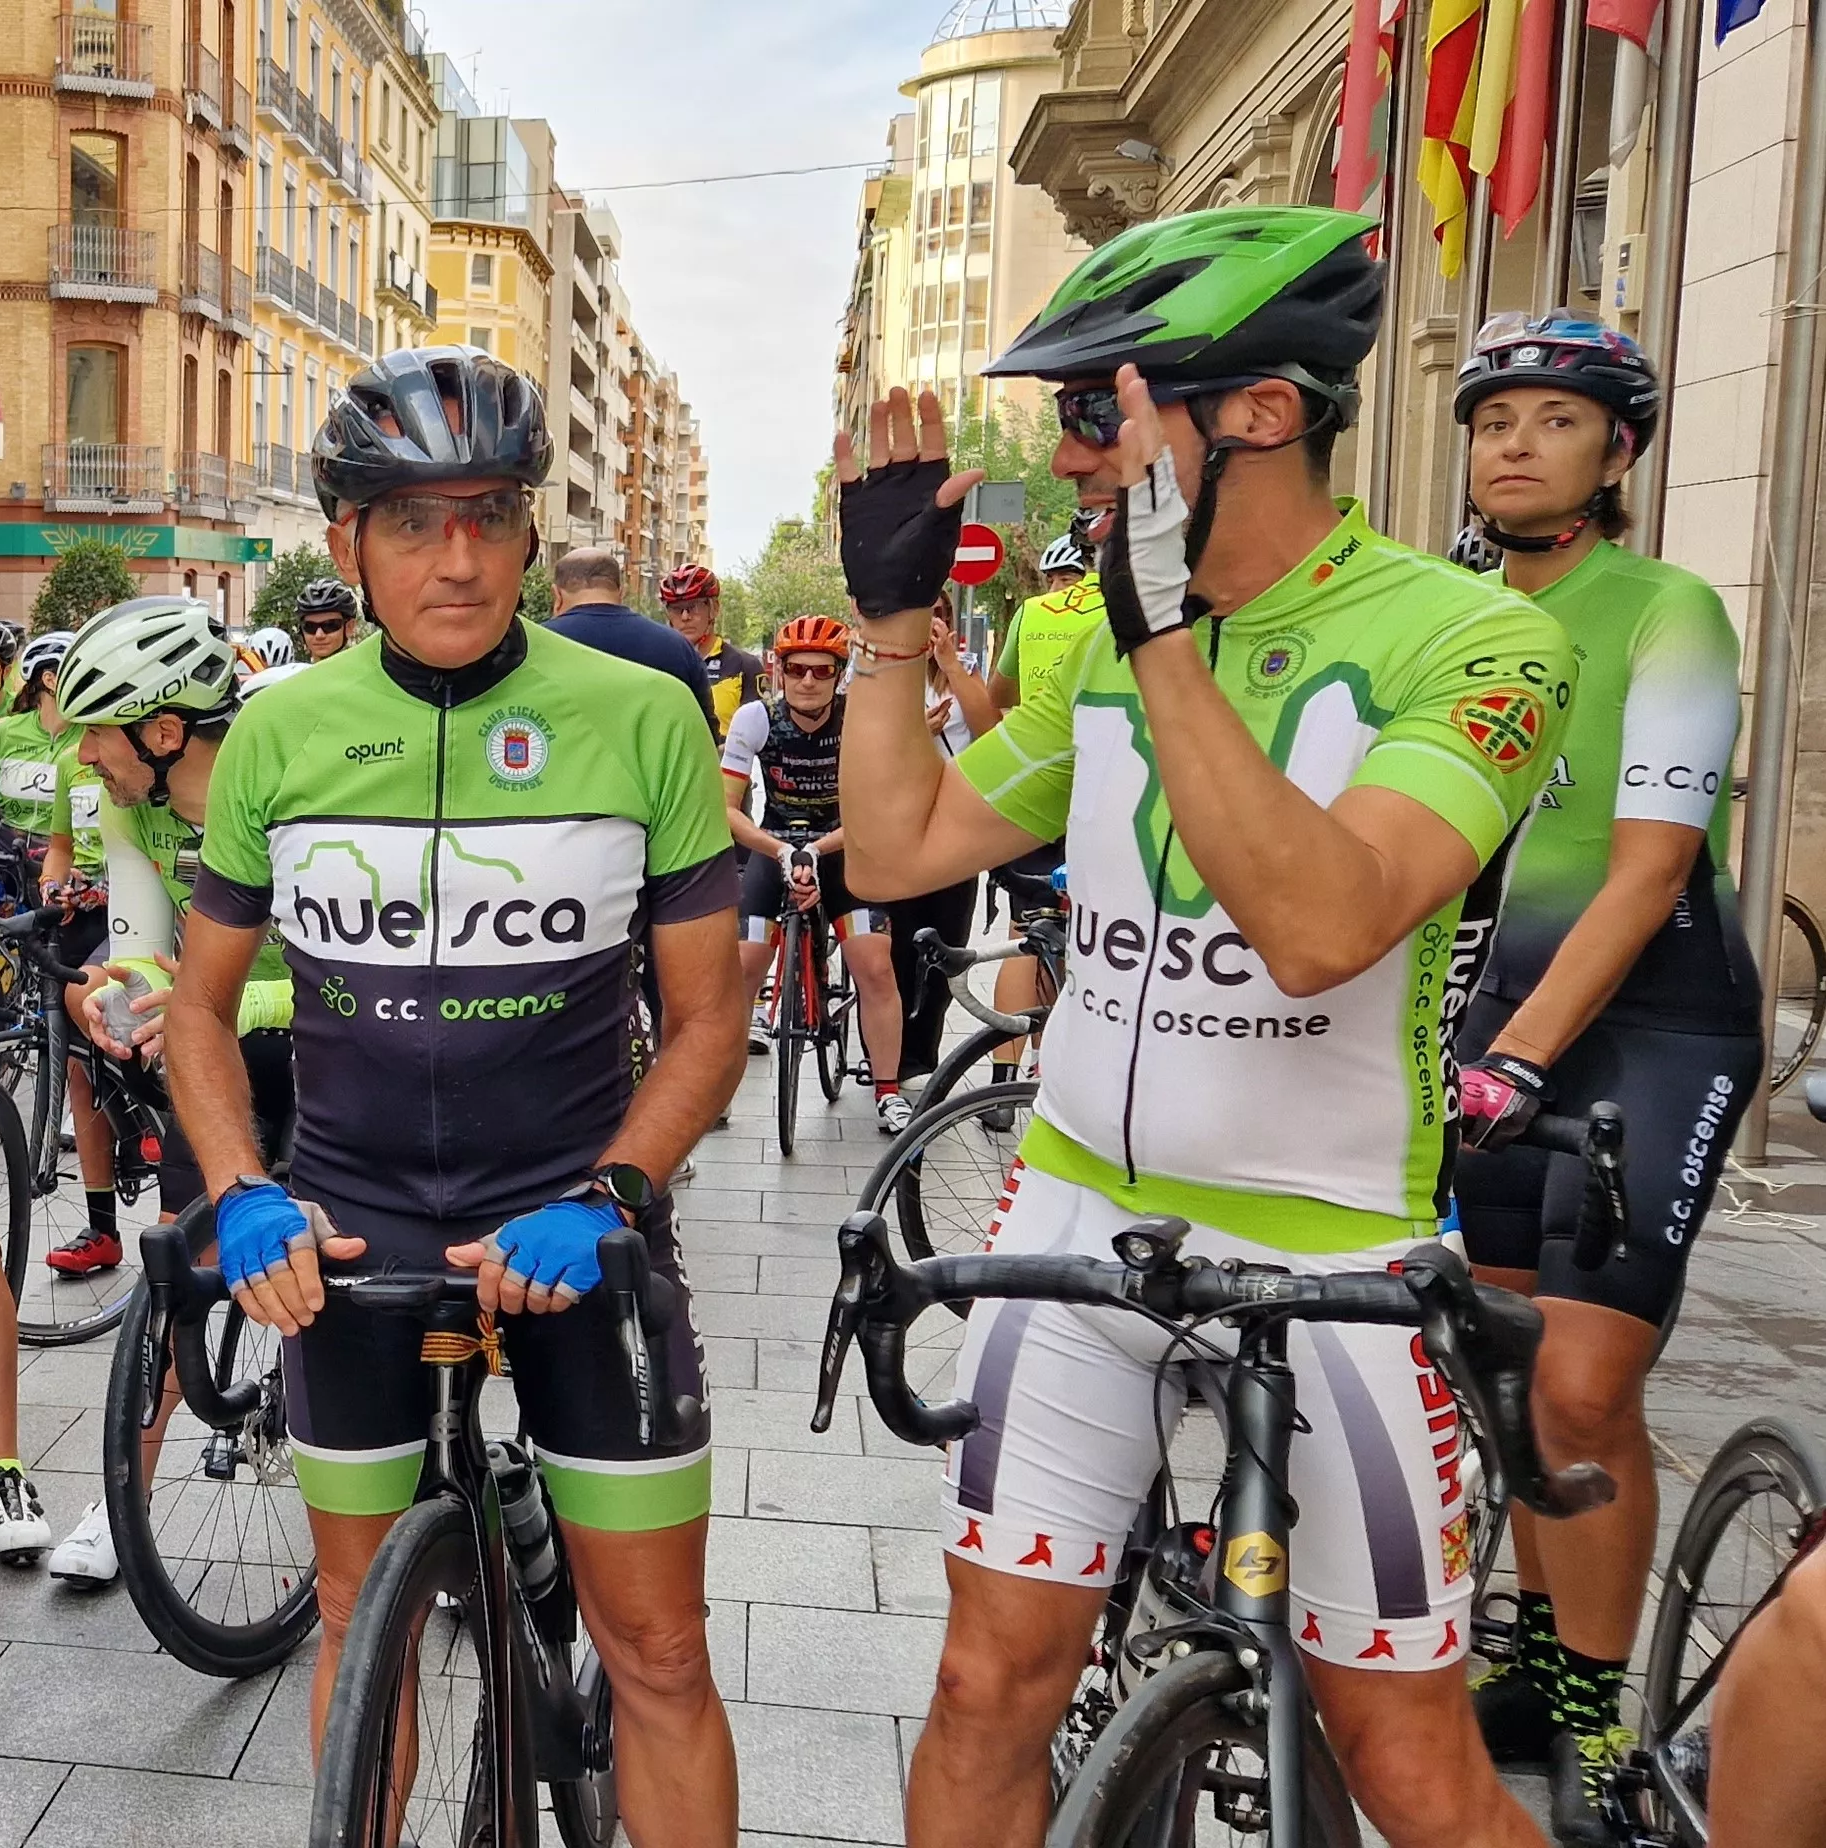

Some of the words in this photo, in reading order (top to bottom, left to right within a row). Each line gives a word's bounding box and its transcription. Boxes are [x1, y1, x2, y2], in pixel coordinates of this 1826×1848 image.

[345, 736, 405, 765] apunt
[478, 708, 506, 738] CLUB
[1624, 764, 1719, 796] C.C.O
[293, 885, 587, 949] huesca
[1070, 903, 1254, 987] uesc
[375, 997, 425, 1021] c.c.
[439, 990, 566, 1021] oscense
[1083, 988, 1128, 1026] c.c.
[1152, 1008, 1331, 1039] oscense
[1436, 917, 1493, 1124] huesca
[1413, 1024, 1436, 1127] oscense
[1665, 1198, 1695, 1245] c.c.
[1680, 1074, 1734, 1187] oscense
